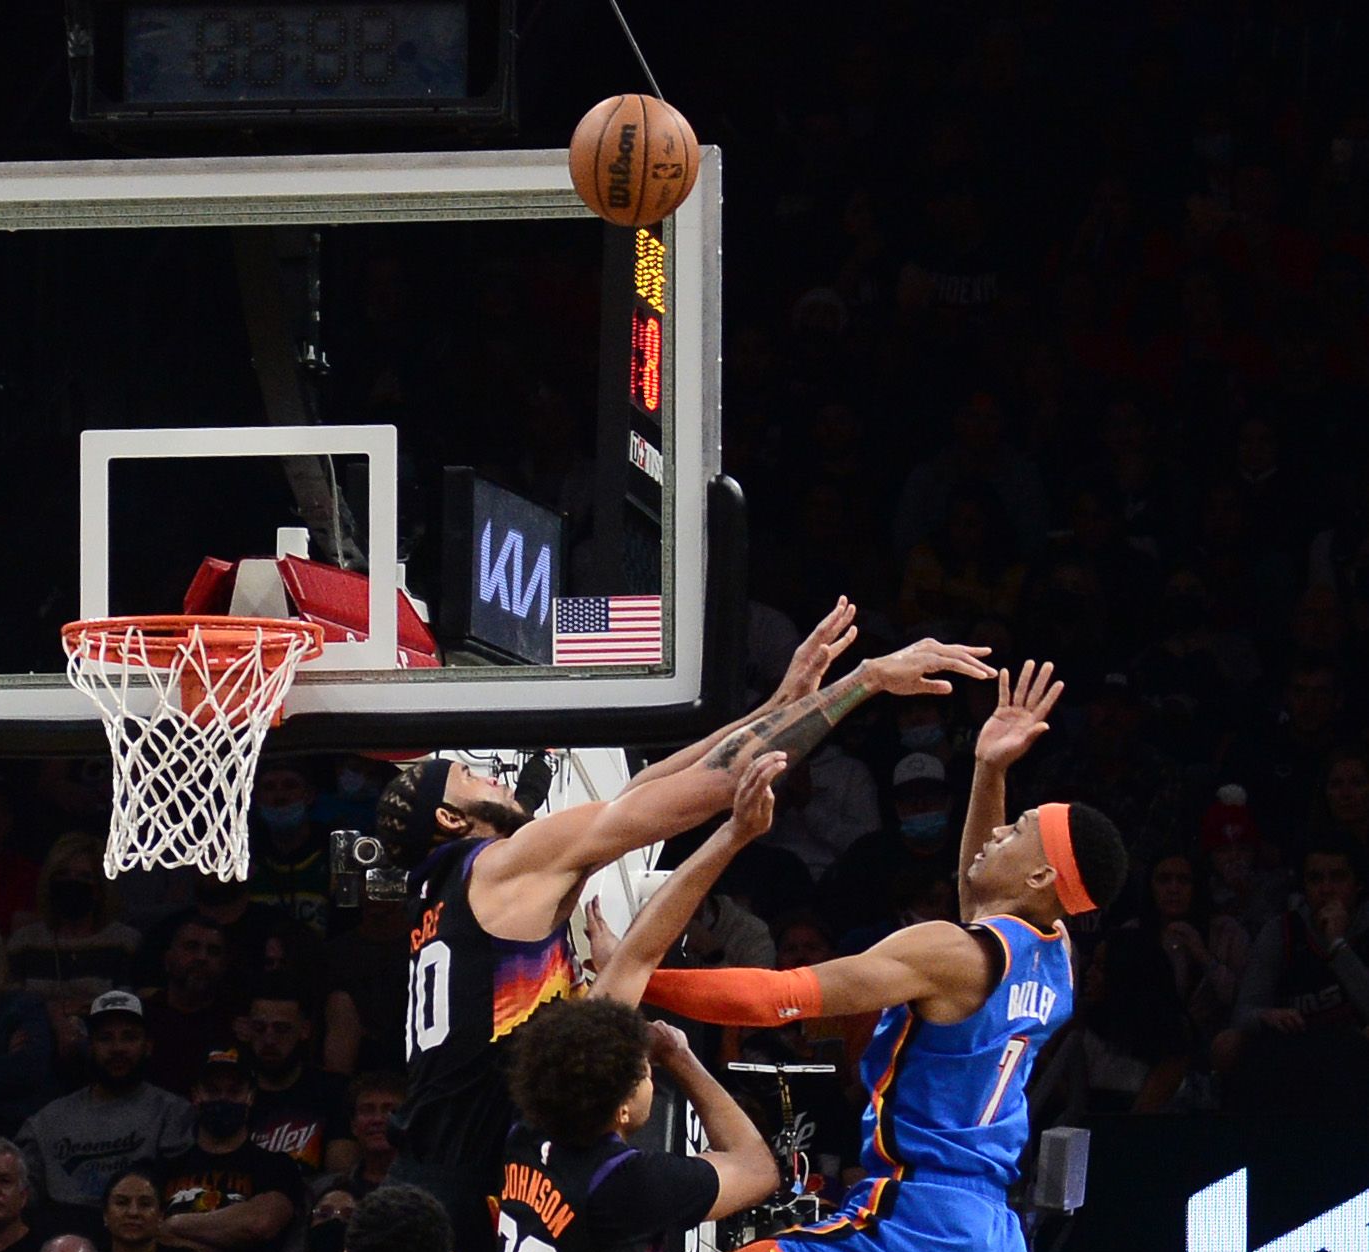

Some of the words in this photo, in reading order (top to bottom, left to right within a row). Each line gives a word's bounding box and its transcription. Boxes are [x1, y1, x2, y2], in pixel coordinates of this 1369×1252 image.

[609, 124, 636, 208] Wilson
[405, 940, 452, 1064] 0
[974, 1034, 1029, 1128] 7
[501, 1162, 576, 1240] JOHNSON
